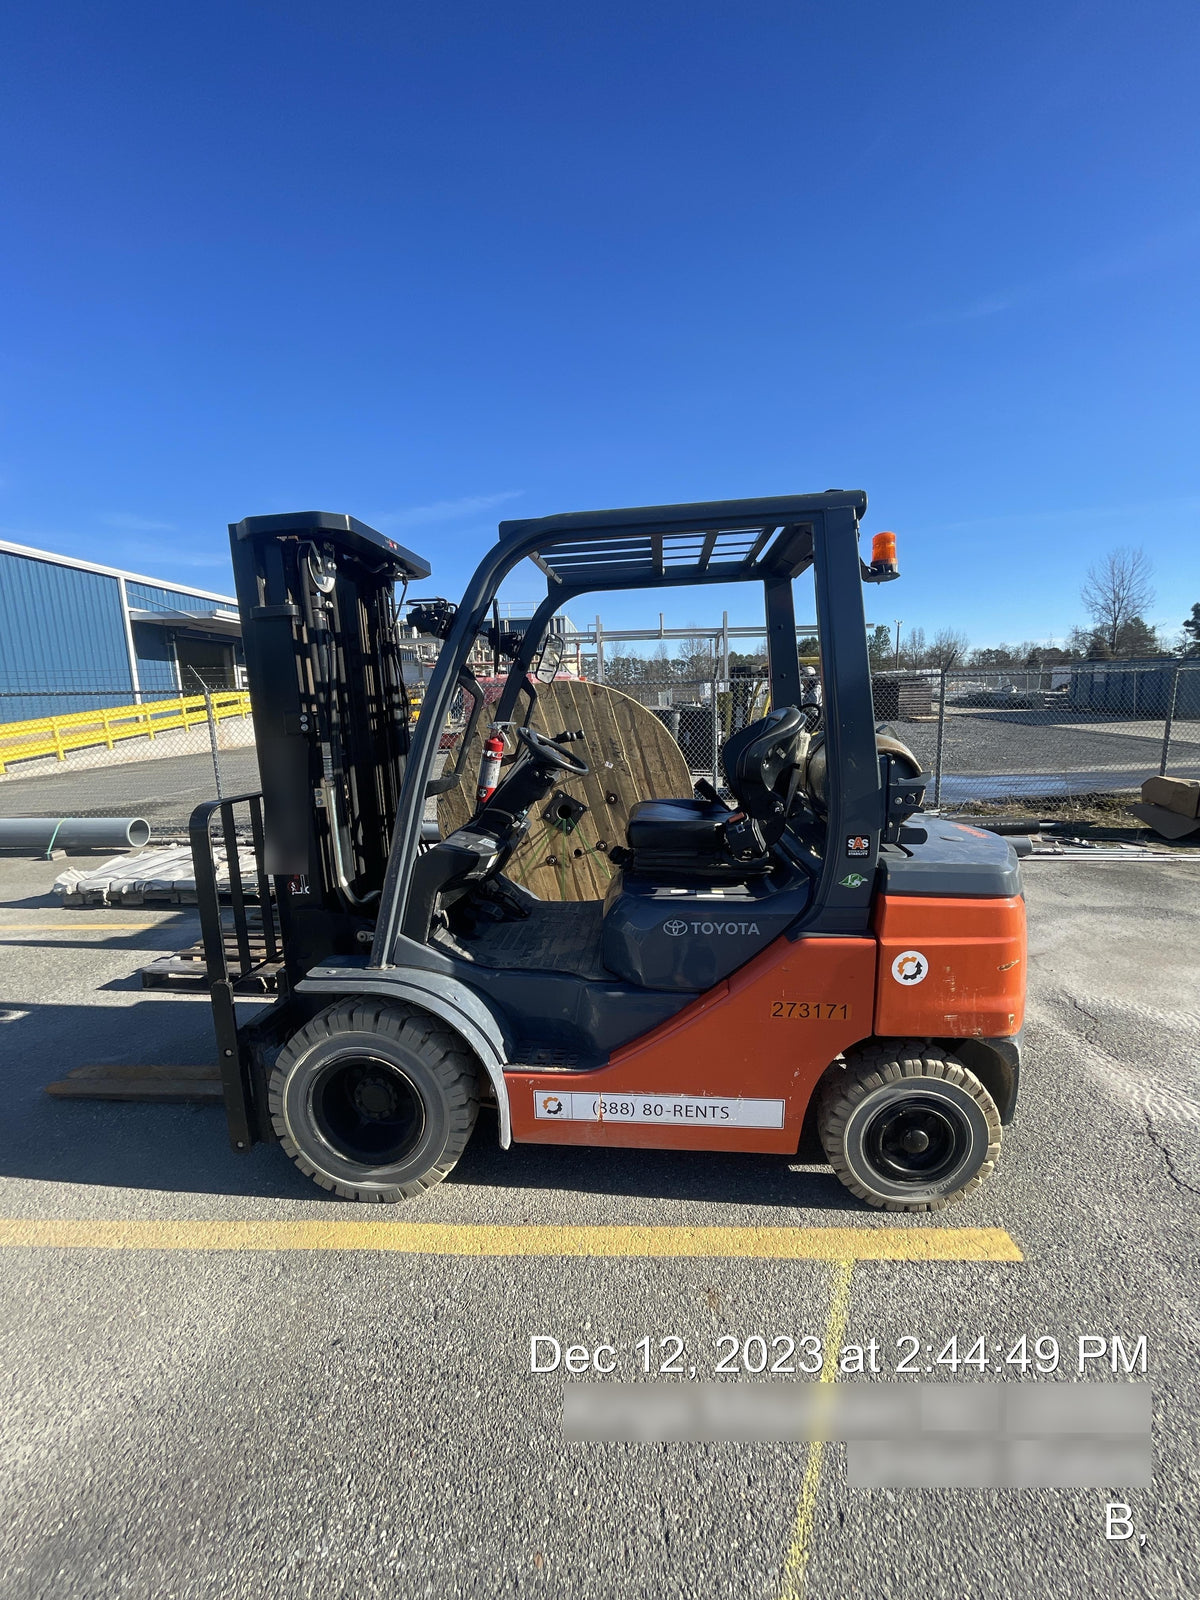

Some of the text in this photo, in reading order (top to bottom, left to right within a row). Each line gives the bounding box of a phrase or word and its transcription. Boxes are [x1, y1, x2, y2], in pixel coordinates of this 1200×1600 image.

[847, 836, 869, 850] SAS
[690, 921, 761, 936] TOYOTA
[772, 1001, 848, 1020] 273171
[592, 1100, 729, 1119] (888) 80-RENTS
